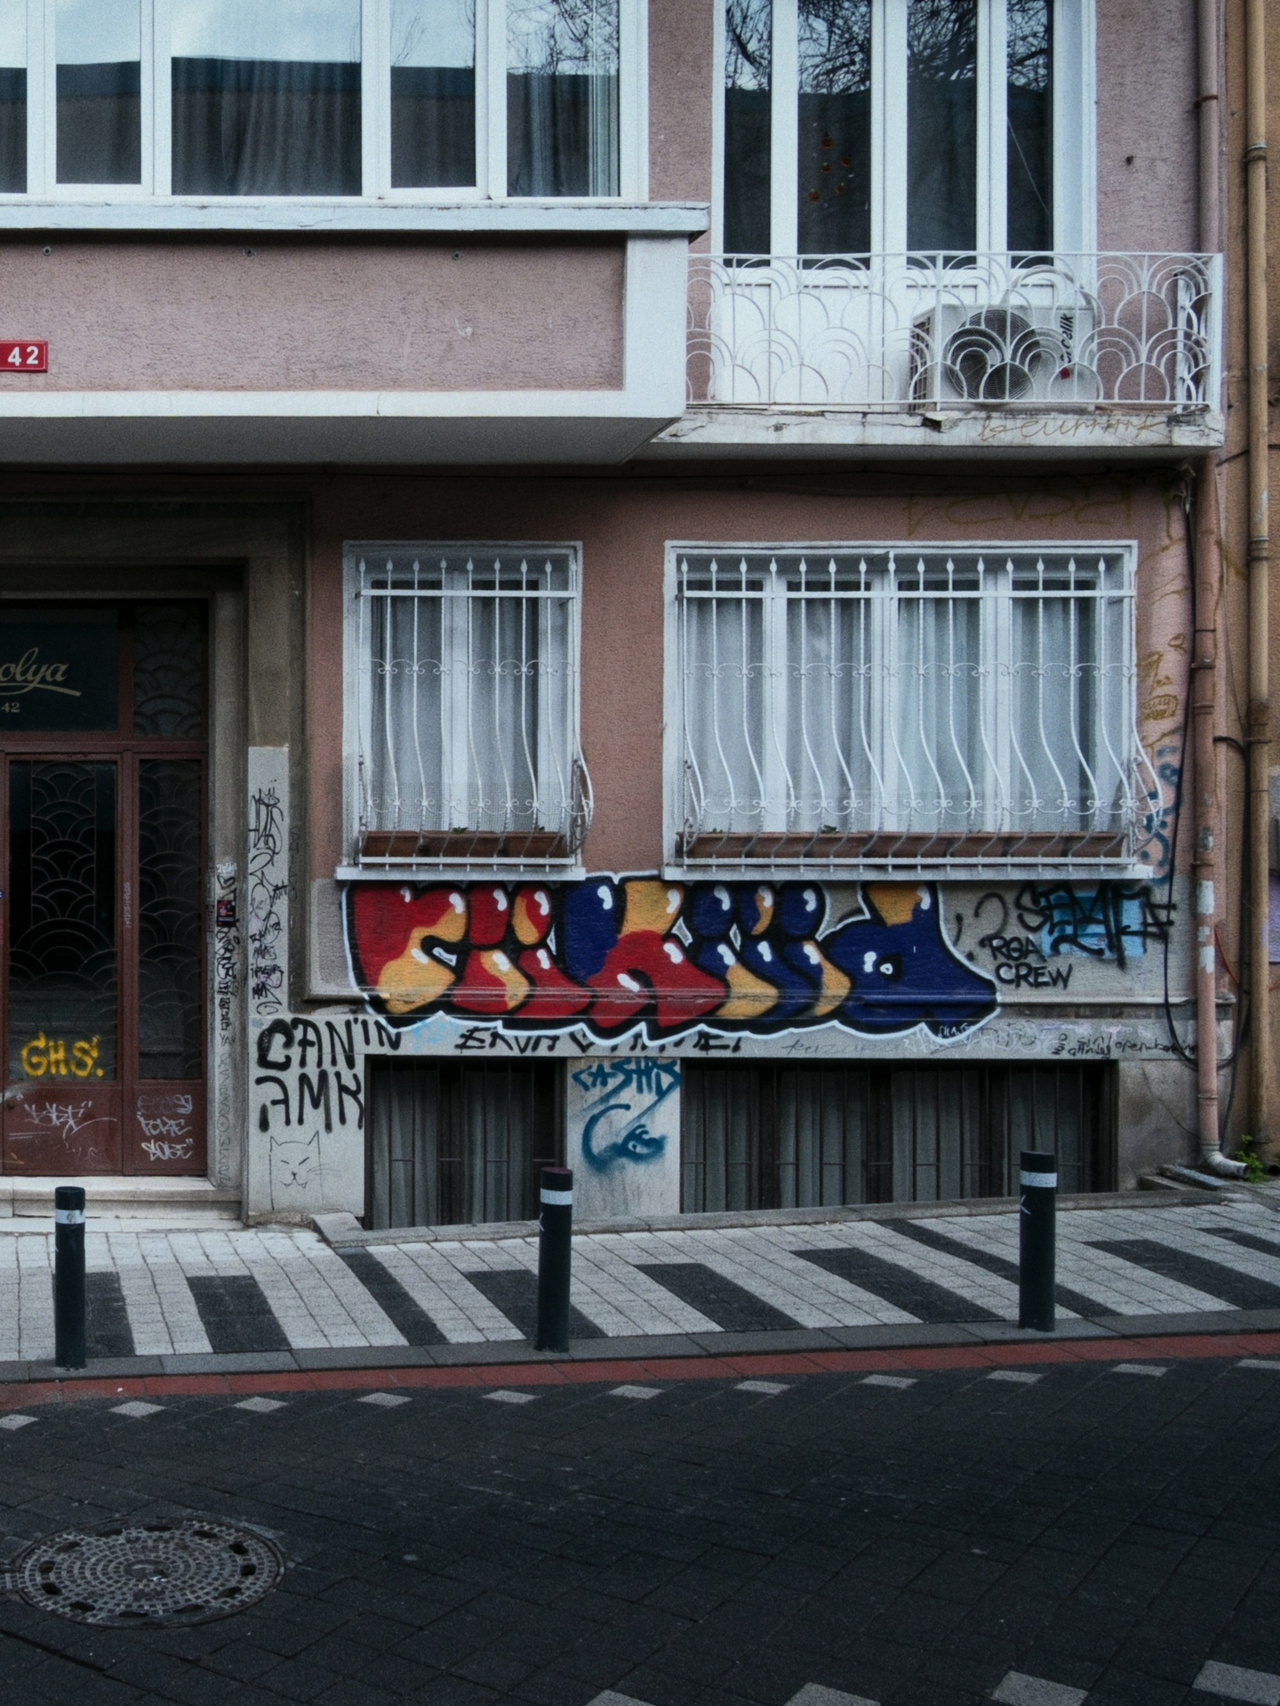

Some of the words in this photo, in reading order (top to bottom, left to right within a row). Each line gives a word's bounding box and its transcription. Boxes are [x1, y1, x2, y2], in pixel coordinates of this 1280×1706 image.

[7, 345, 40, 367] 42
[0, 701, 21, 714] 42
[994, 961, 1074, 990] CREW
